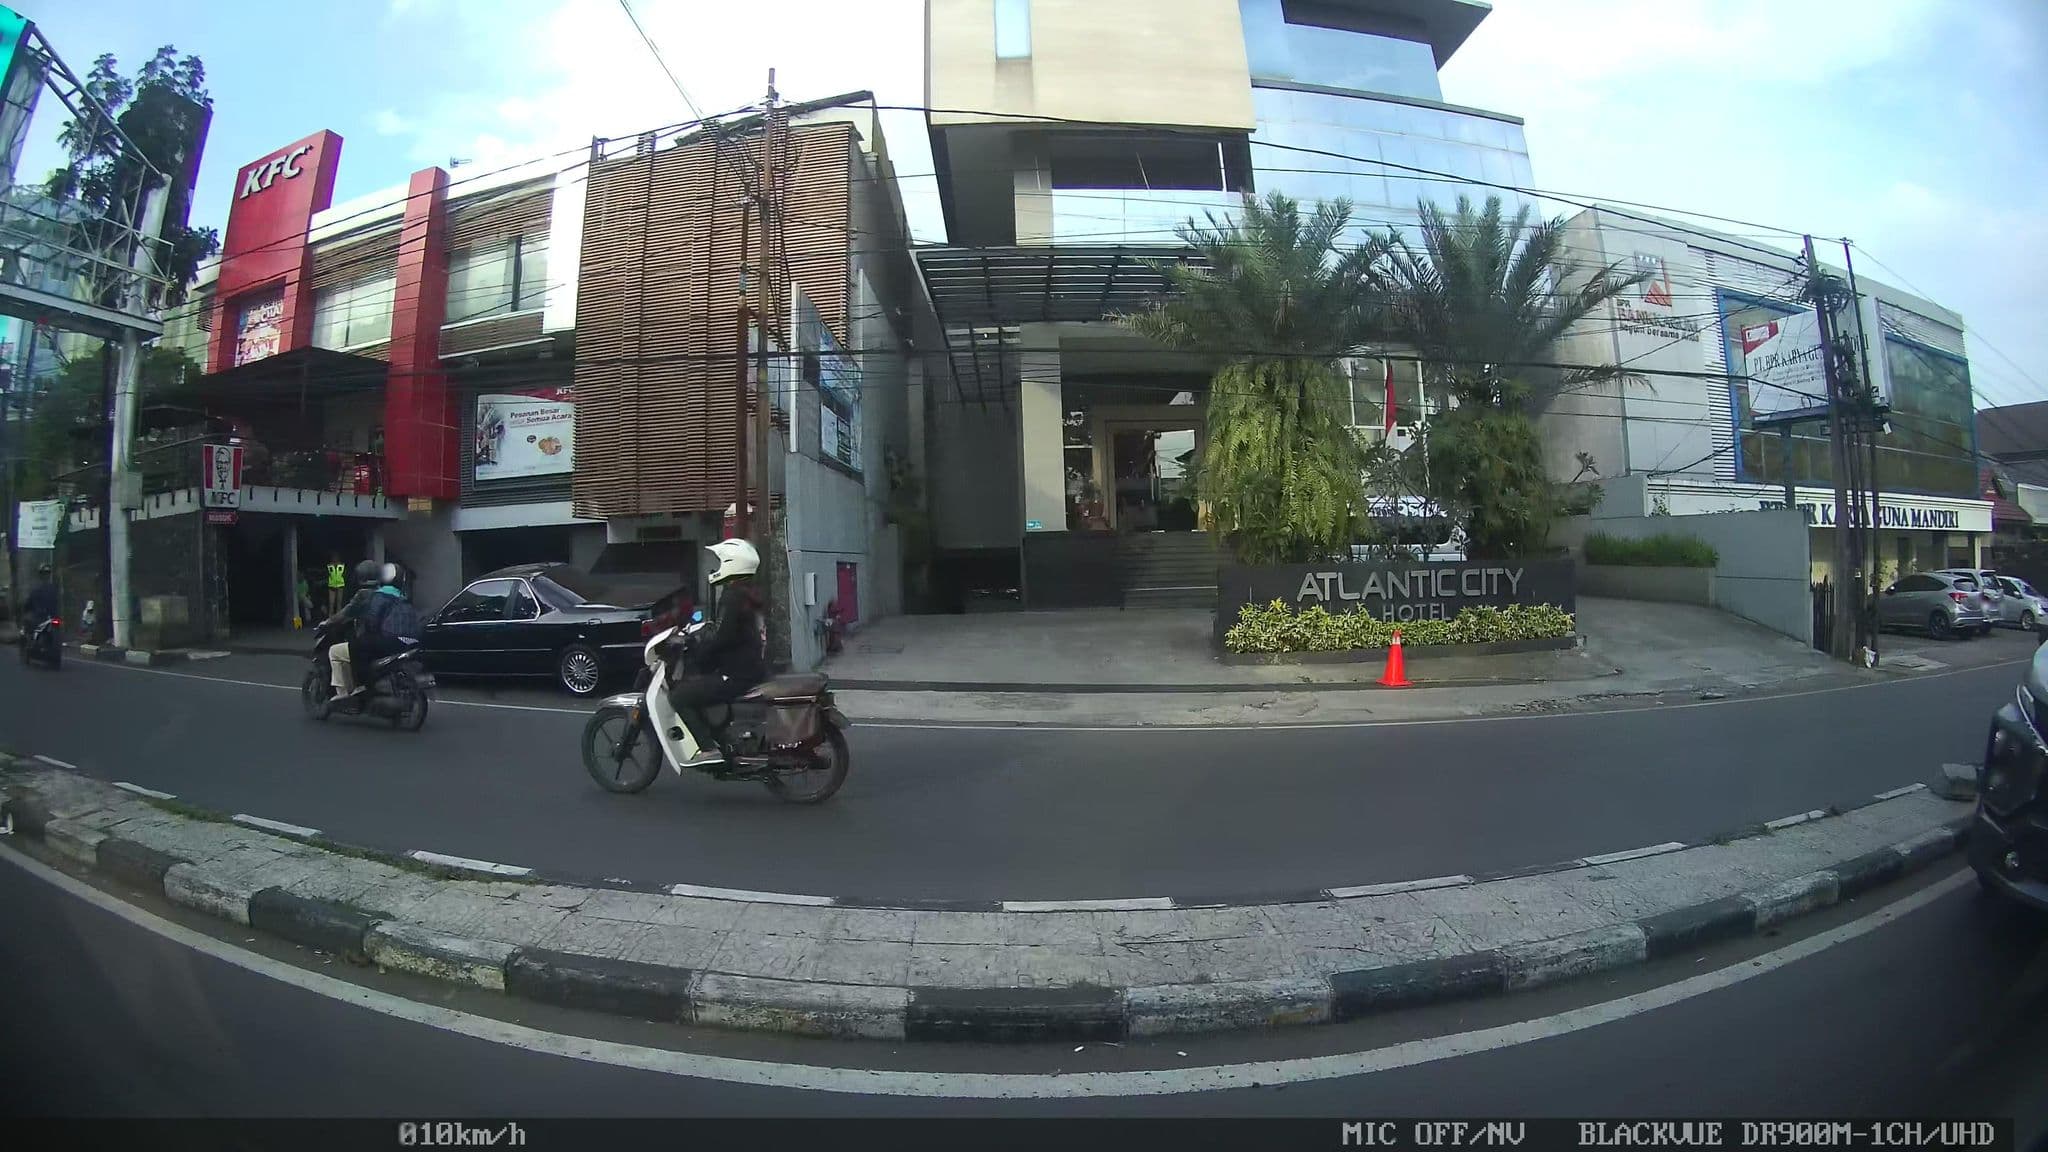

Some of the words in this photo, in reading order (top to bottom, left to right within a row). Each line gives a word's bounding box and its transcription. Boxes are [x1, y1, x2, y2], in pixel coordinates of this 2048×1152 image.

[240, 145, 309, 199] KFC
[510, 411, 539, 419] Pesanan
[526, 415, 550, 424] Semua
[551, 412, 573, 421] Acara
[1878, 505, 1909, 527] UNA
[1910, 507, 1960, 529] MANDIRI
[1296, 568, 1456, 602] ATLANTIC
[1460, 567, 1524, 597] CITY
[1382, 602, 1451, 624] HOTEL
